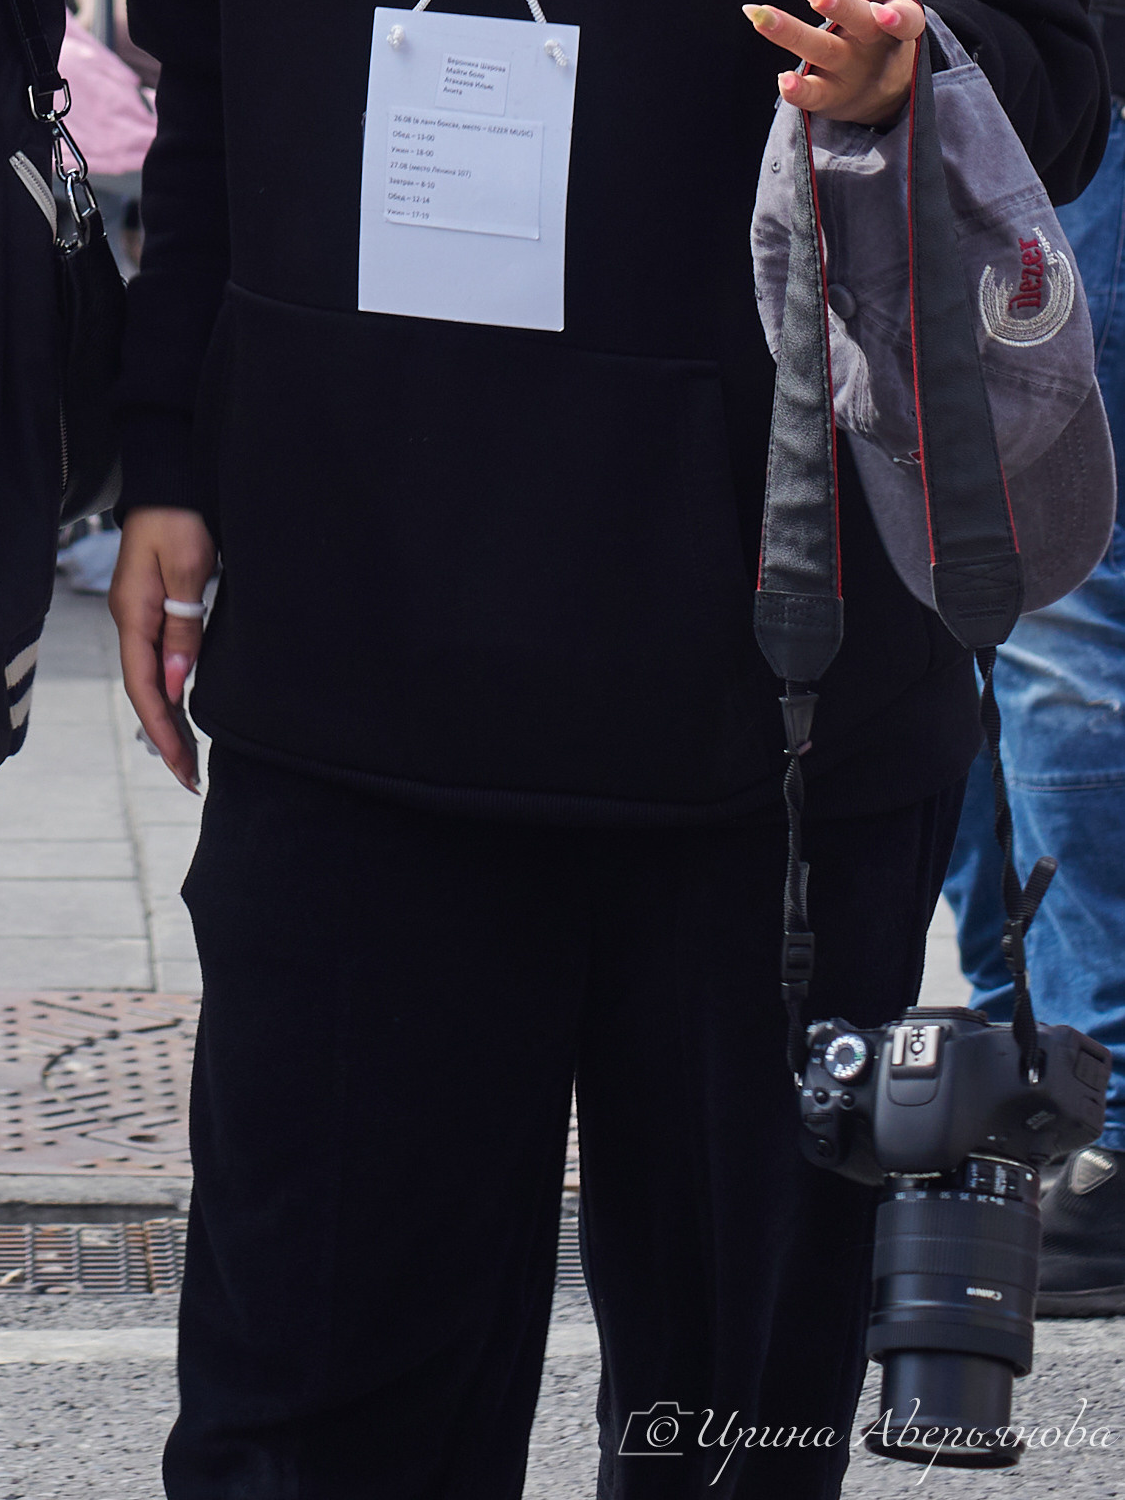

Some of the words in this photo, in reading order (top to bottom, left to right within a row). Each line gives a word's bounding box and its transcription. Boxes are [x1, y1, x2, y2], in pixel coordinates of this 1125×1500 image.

[447, 56, 479, 68] Вероника
[392, 130, 411, 140] Обед
[387, 192, 406, 202] Обед
[1032, 226, 1058, 266] project
